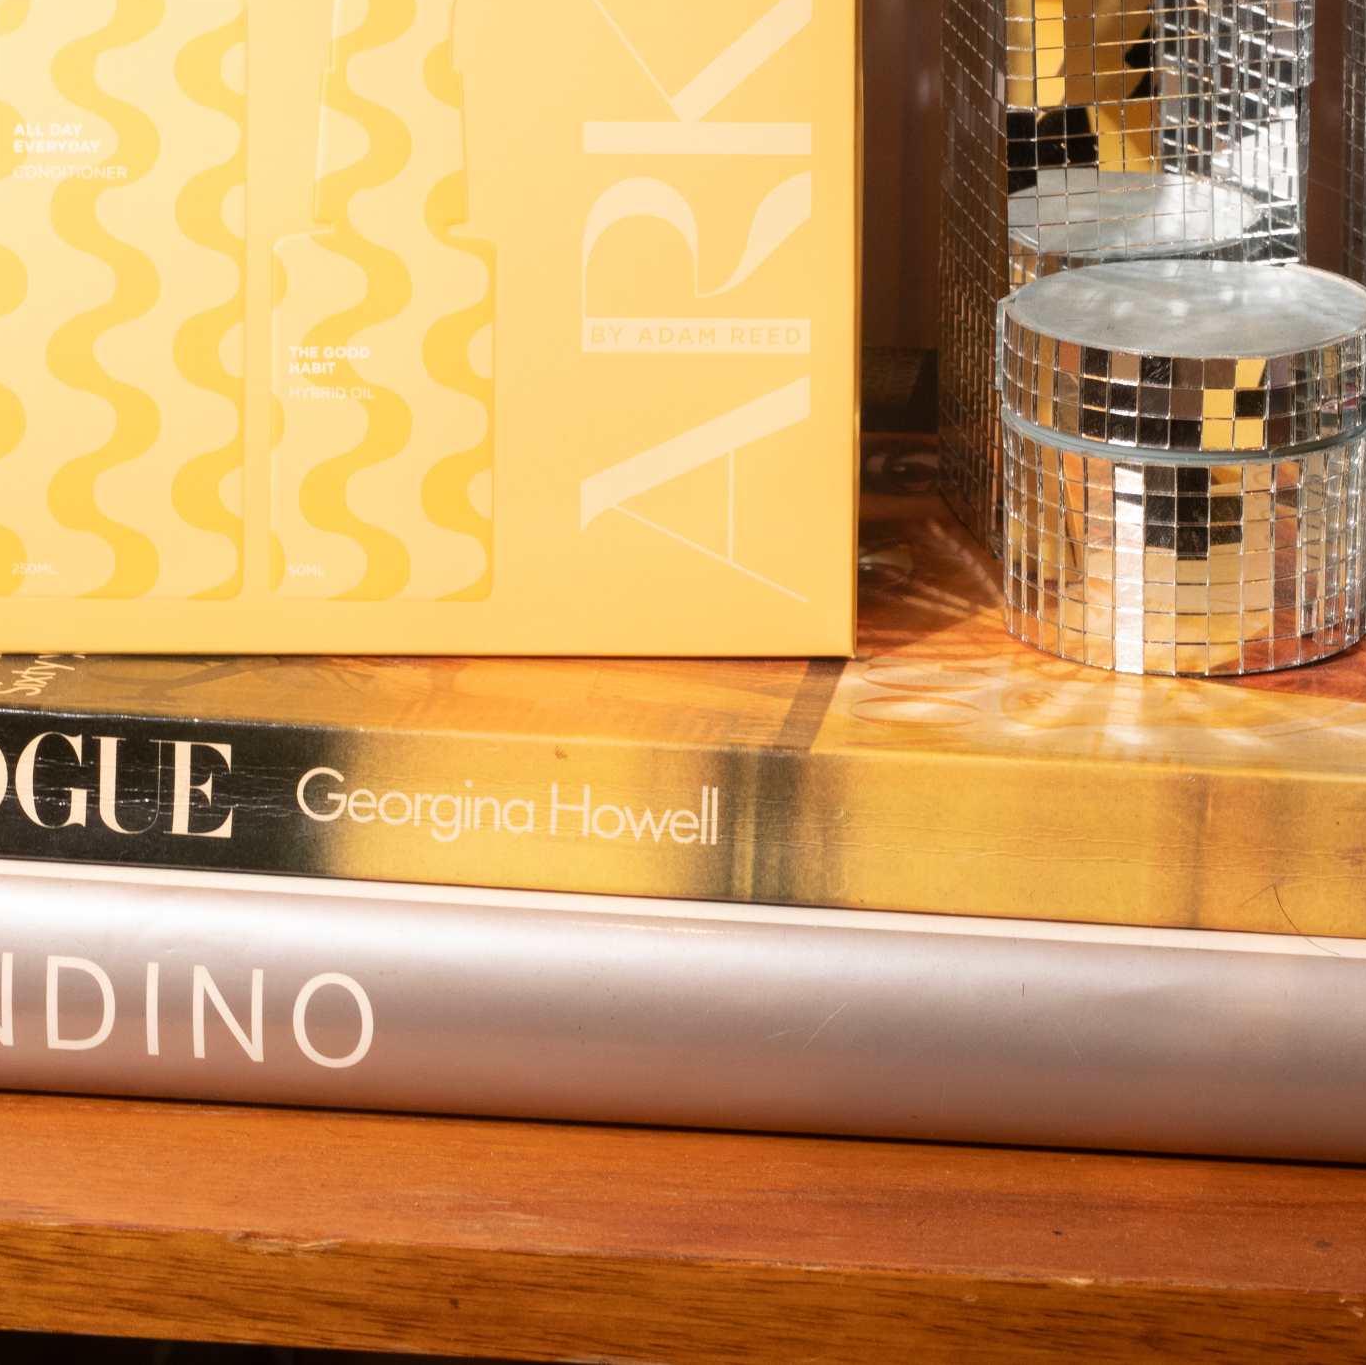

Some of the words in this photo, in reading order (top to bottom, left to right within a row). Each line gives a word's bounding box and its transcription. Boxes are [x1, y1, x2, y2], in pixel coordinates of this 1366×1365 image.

[13, 123, 46, 136] ALL
[49, 123, 83, 137] DAY
[13, 140, 101, 154] EVERYDAY
[13, 165, 128, 179] CONDITIONER
[590, 326, 624, 344] BY
[637, 326, 717, 345] ADAM
[729, 326, 802, 345] REED
[288, 345, 319, 359] THE
[323, 345, 371, 360] GOOD
[288, 361, 337, 375] HABIT
[288, 386, 346, 400] HYBRID
[350, 386, 376, 400] OIL
[11, 563, 58, 576] 250ML
[288, 564, 325, 576] 50ML
[295, 766, 535, 843] Georgina
[549, 782, 720, 846] Howell
